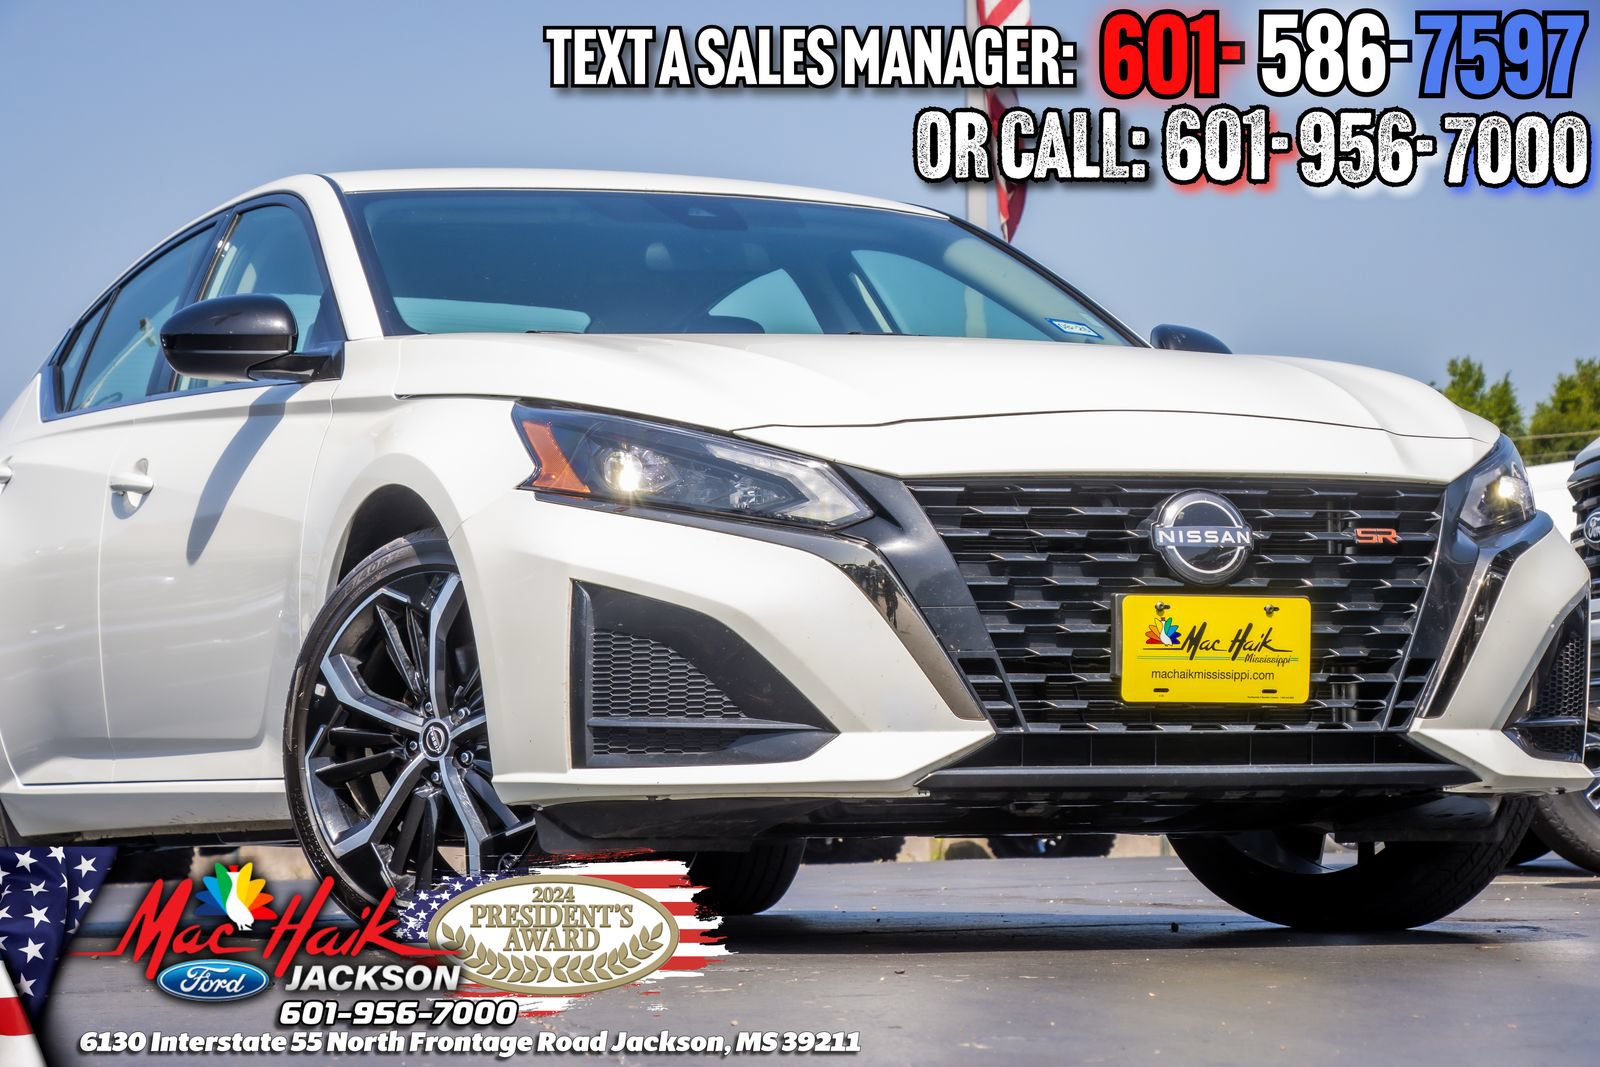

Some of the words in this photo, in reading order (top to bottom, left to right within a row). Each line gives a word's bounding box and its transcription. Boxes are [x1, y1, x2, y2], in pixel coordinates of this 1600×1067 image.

[1158, 530, 1251, 544] NISSAN
[1354, 527, 1398, 544] SR
[1170, 622, 1227, 661] Mac
[1228, 622, 1282, 661] Haik
[1244, 653, 1292, 667] Mississippi
[1151, 668, 1275, 682] machaikmississippi.com
